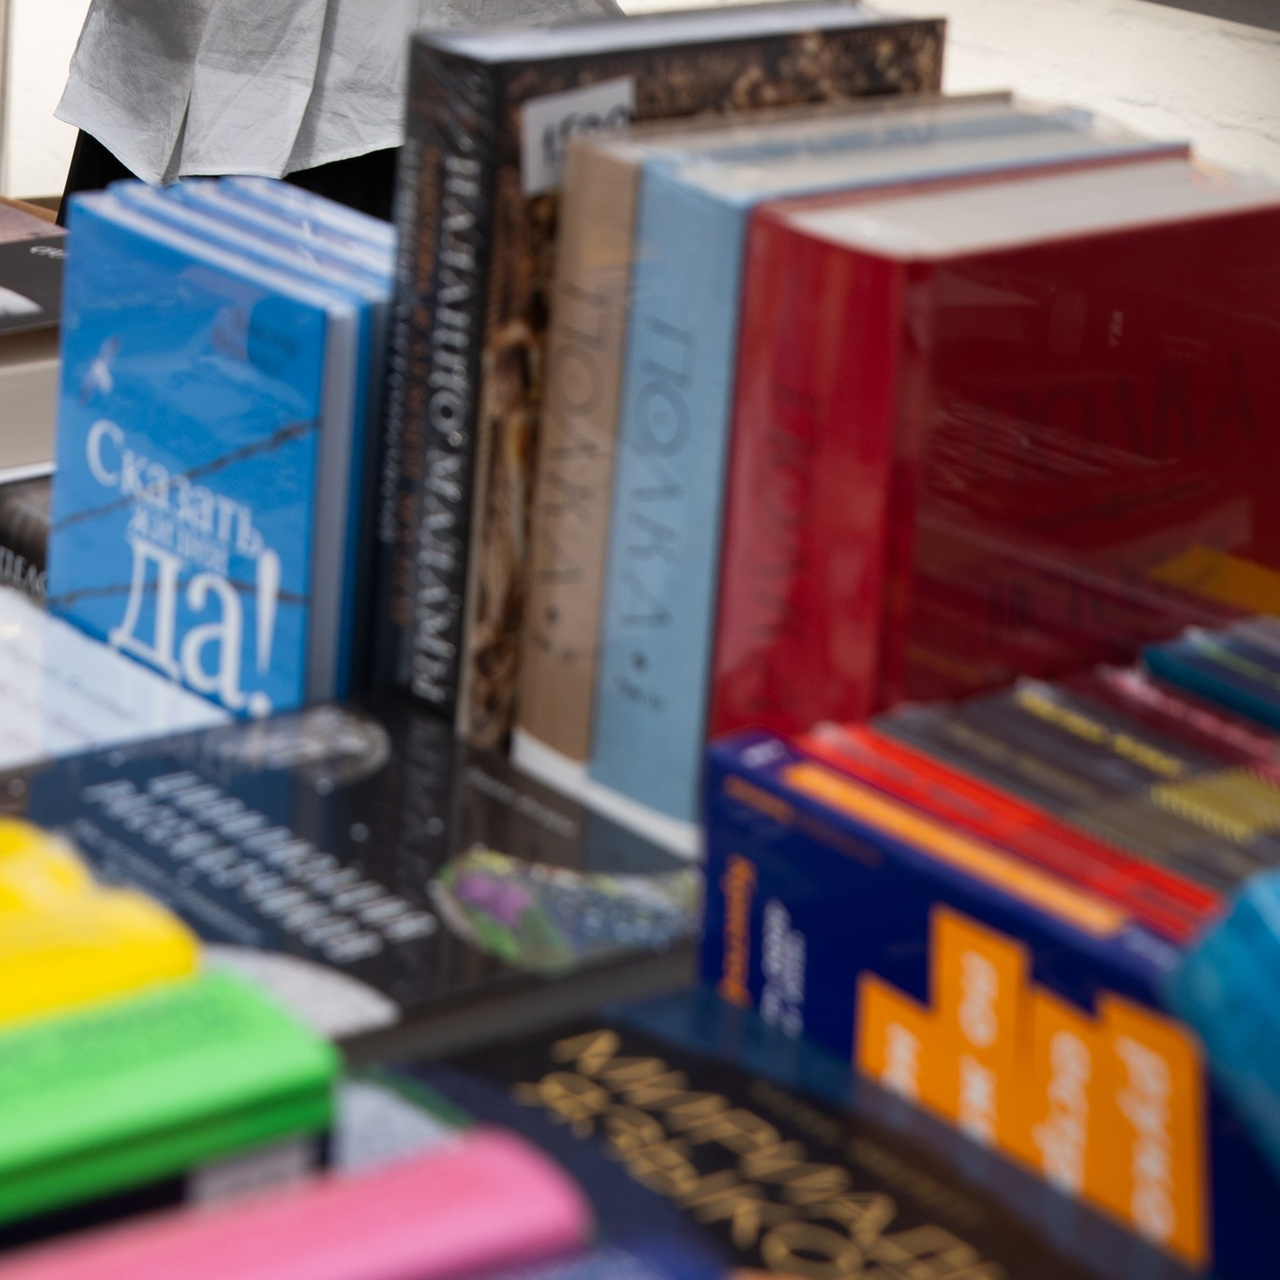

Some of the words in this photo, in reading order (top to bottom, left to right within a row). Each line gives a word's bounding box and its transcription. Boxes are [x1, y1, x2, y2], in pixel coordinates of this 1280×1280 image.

[86, 418, 267, 560] Сказать
[620, 314, 694, 631] ПОЛКА
[107, 539, 282, 718] Да!
